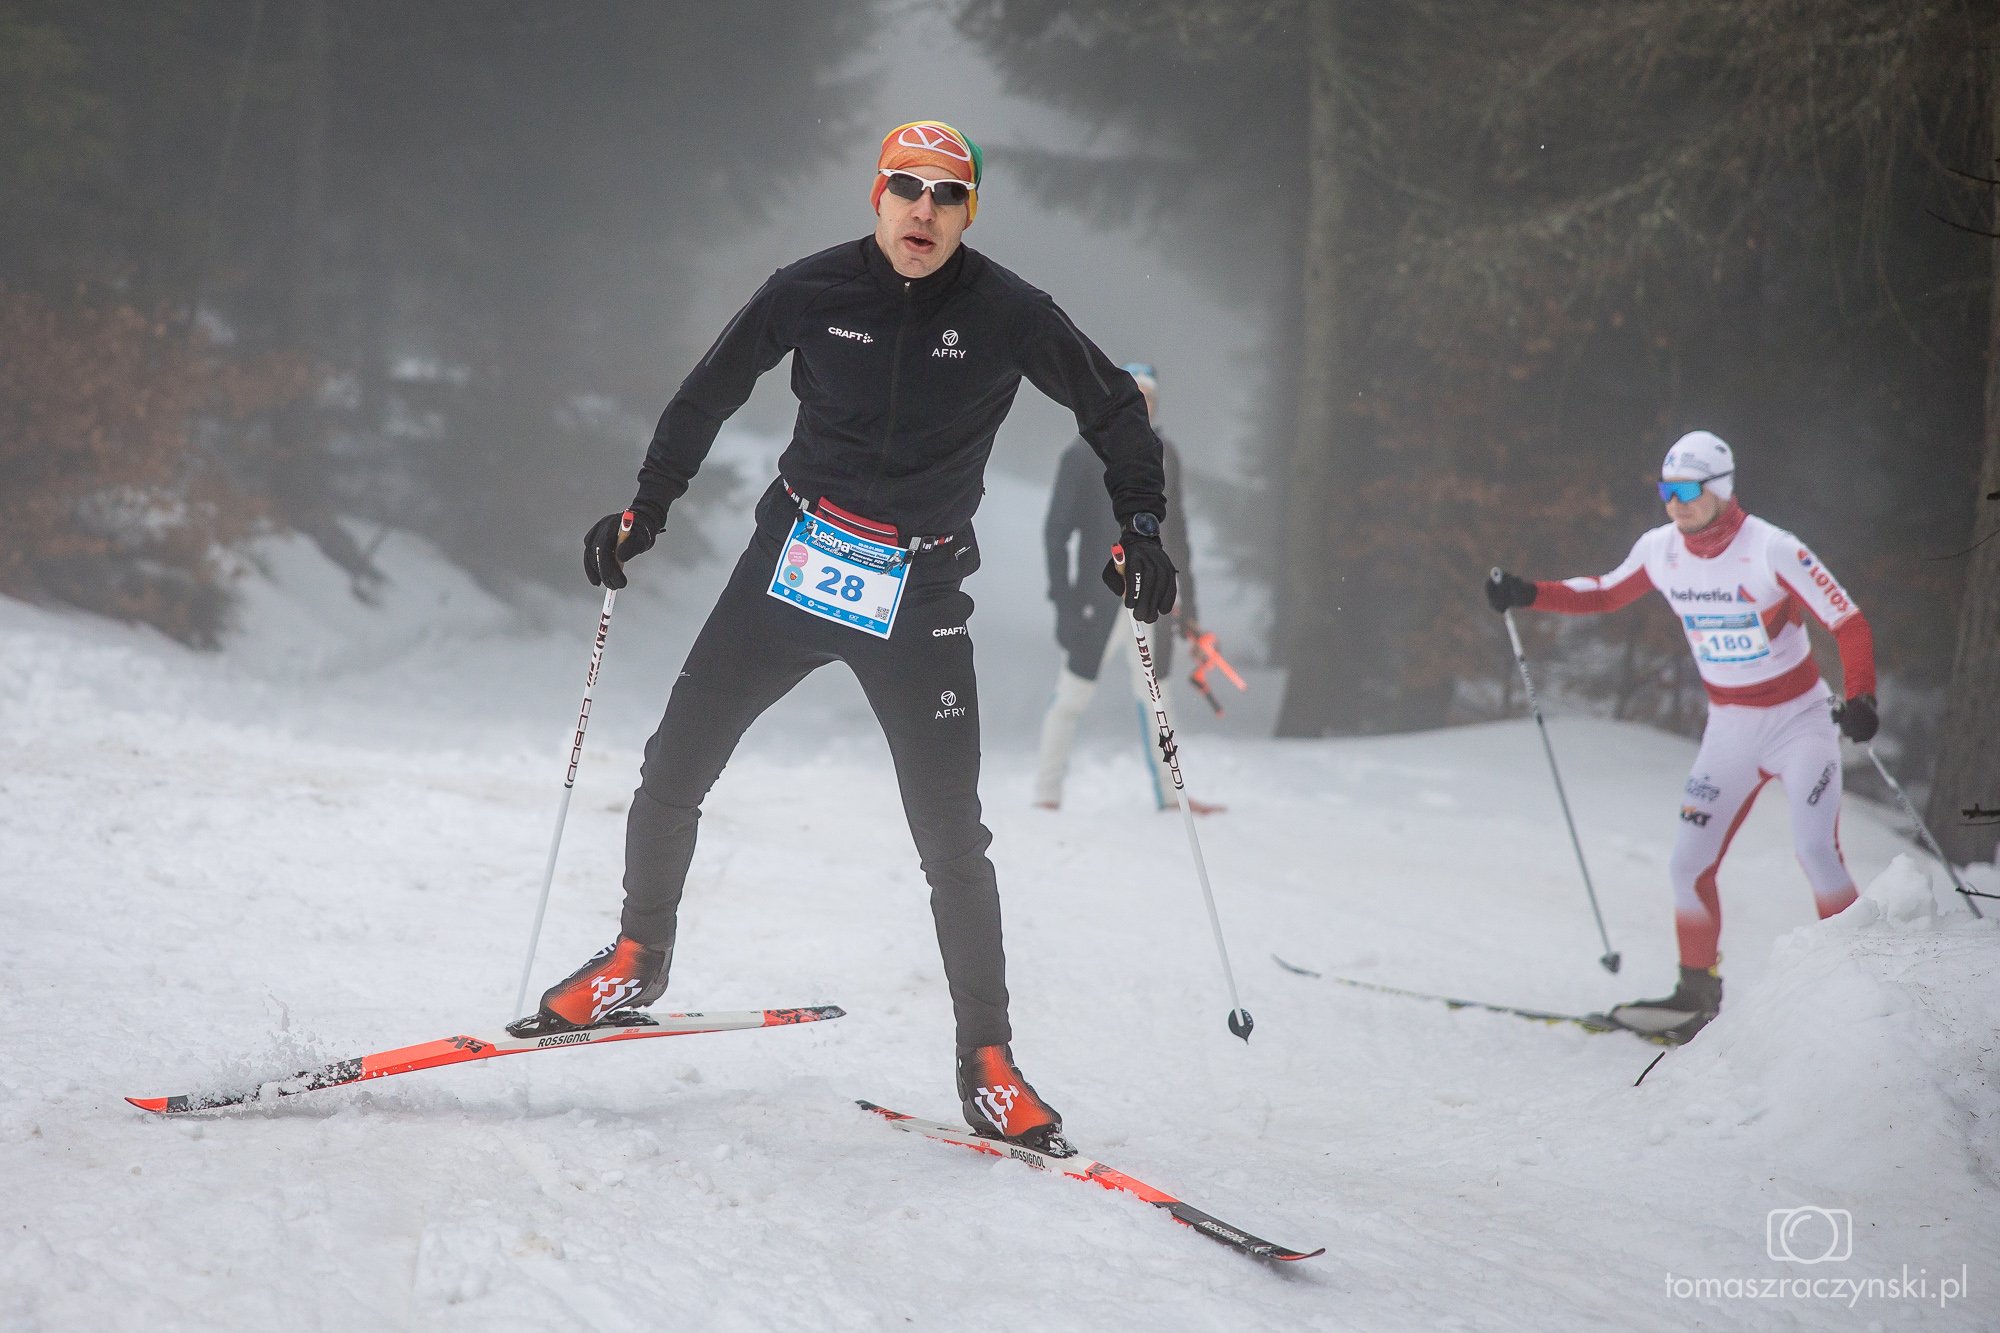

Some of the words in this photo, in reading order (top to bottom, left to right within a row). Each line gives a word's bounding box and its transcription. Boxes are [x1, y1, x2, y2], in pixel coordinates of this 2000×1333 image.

[828, 326, 864, 341] CRAFT
[932, 348, 966, 359] AFRY
[811, 523, 850, 554] Leśna
[815, 566, 865, 602] 28
[1810, 566, 1850, 613] LOTOS
[1670, 588, 1733, 602] helvetia
[932, 626, 964, 637] CRAFT
[1709, 634, 1753, 651] 180
[934, 707, 966, 720] AFRY
[537, 1032, 591, 1048] ROSSIGNOL
[1010, 1148, 1046, 1169] ROSSIGNOL
